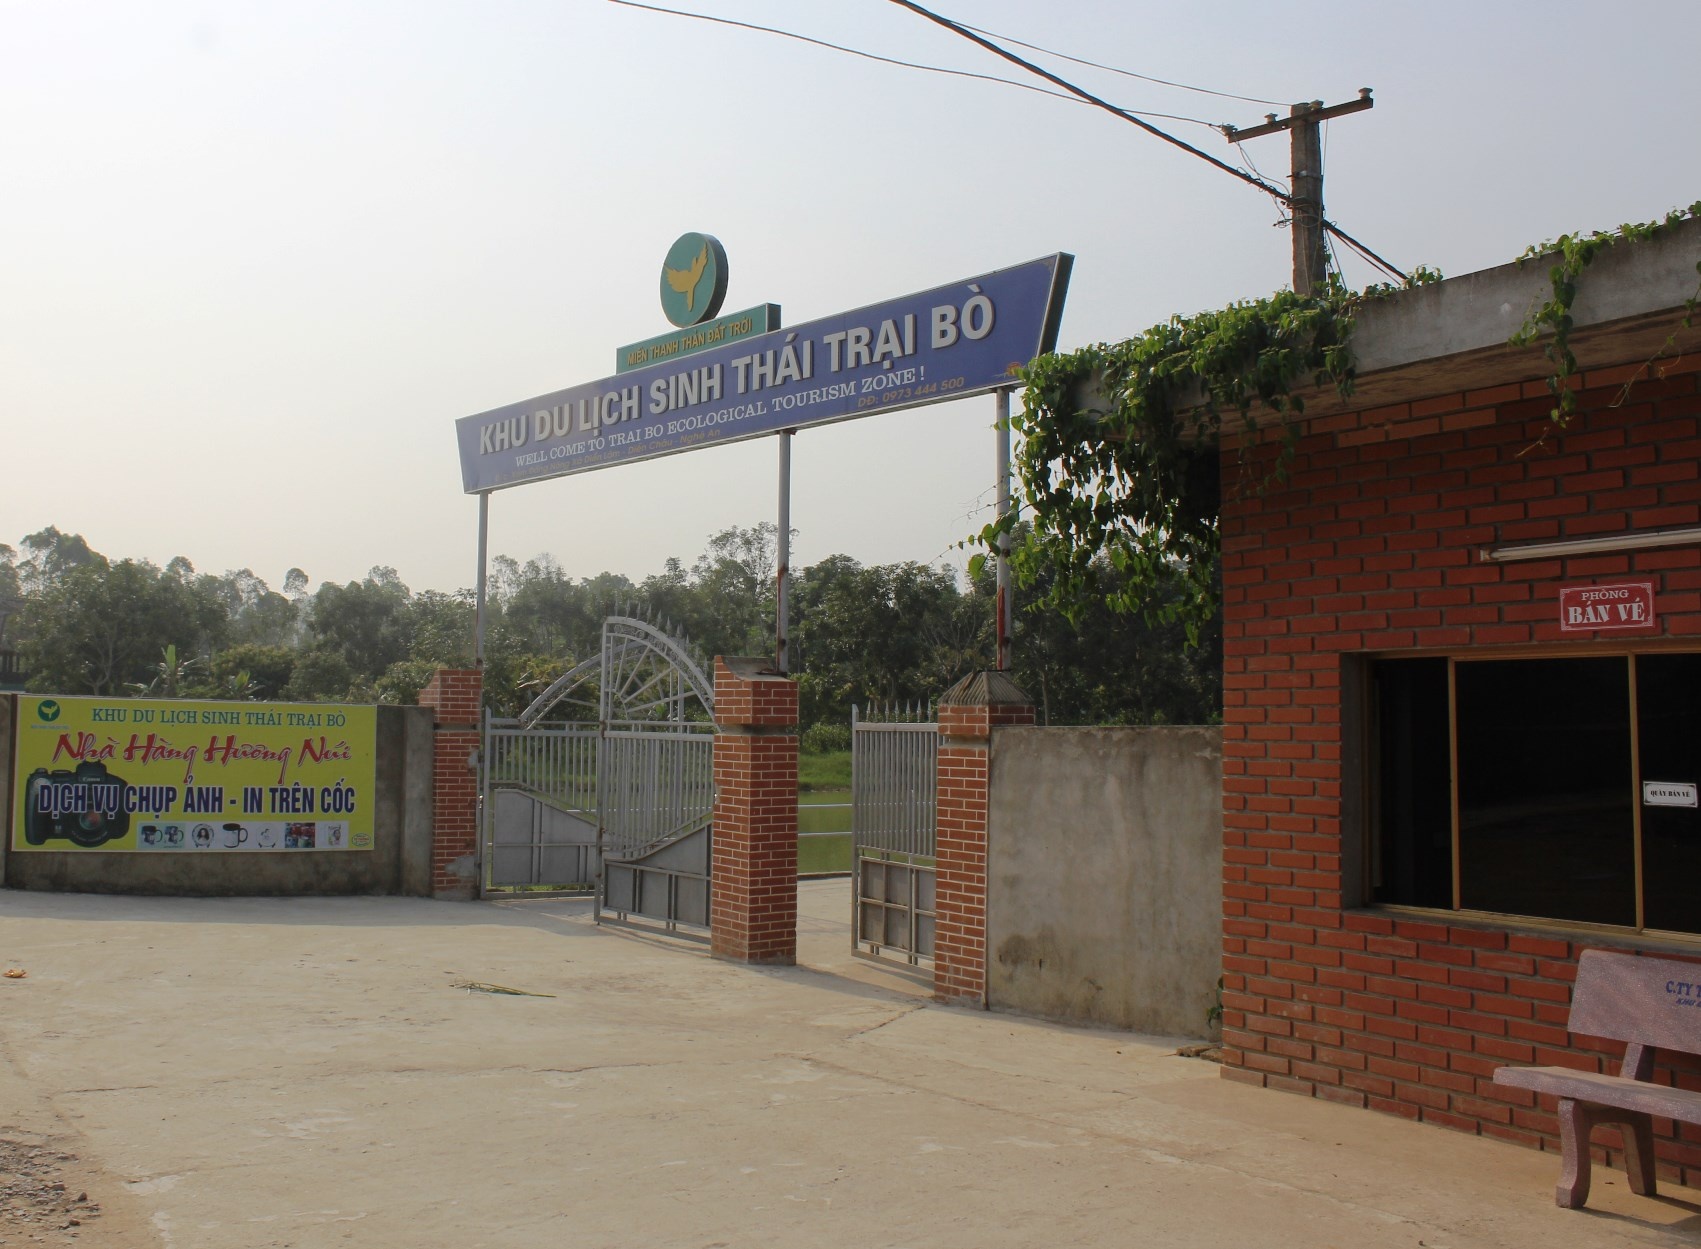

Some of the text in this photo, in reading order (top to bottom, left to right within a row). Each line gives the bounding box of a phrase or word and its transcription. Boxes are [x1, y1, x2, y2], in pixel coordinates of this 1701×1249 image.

[650, 340, 679, 359] THANH
[707, 322, 727, 343] ĐẤT
[479, 284, 995, 455] KHU DU LỊCH SINH THÁI TRẠI BÒ
[882, 386, 912, 403] 0973
[914, 383, 937, 396] 444
[941, 376, 965, 391] 500
[515, 450, 548, 468] WELL
[550, 441, 586, 460] COME
[587, 437, 605, 453] TO
[608, 428, 641, 447] TRAI
[644, 424, 664, 440] BO
[667, 402, 766, 434] ECOLOGICAL
[772, 382, 856, 412] TOURISM
[1568, 597, 1645, 624] BÁN VÉ
[1581, 588, 1630, 601] PHÒNG
[92, 708, 346, 729] KHU DU LỊCH SINH THÁI TRẠI BÒ
[52, 731, 119, 763] Nhà
[123, 732, 199, 784] Hàng
[297, 736, 353, 767] Núi
[38, 784, 88, 820] DỊCH
[91, 784, 120, 820] VỤ
[124, 785, 178, 819] CHỤP
[183, 774, 224, 813] ẢNH
[243, 786, 263, 814] IN
[270, 780, 316, 814] TRÊN
[320, 778, 356, 814] CỐC
